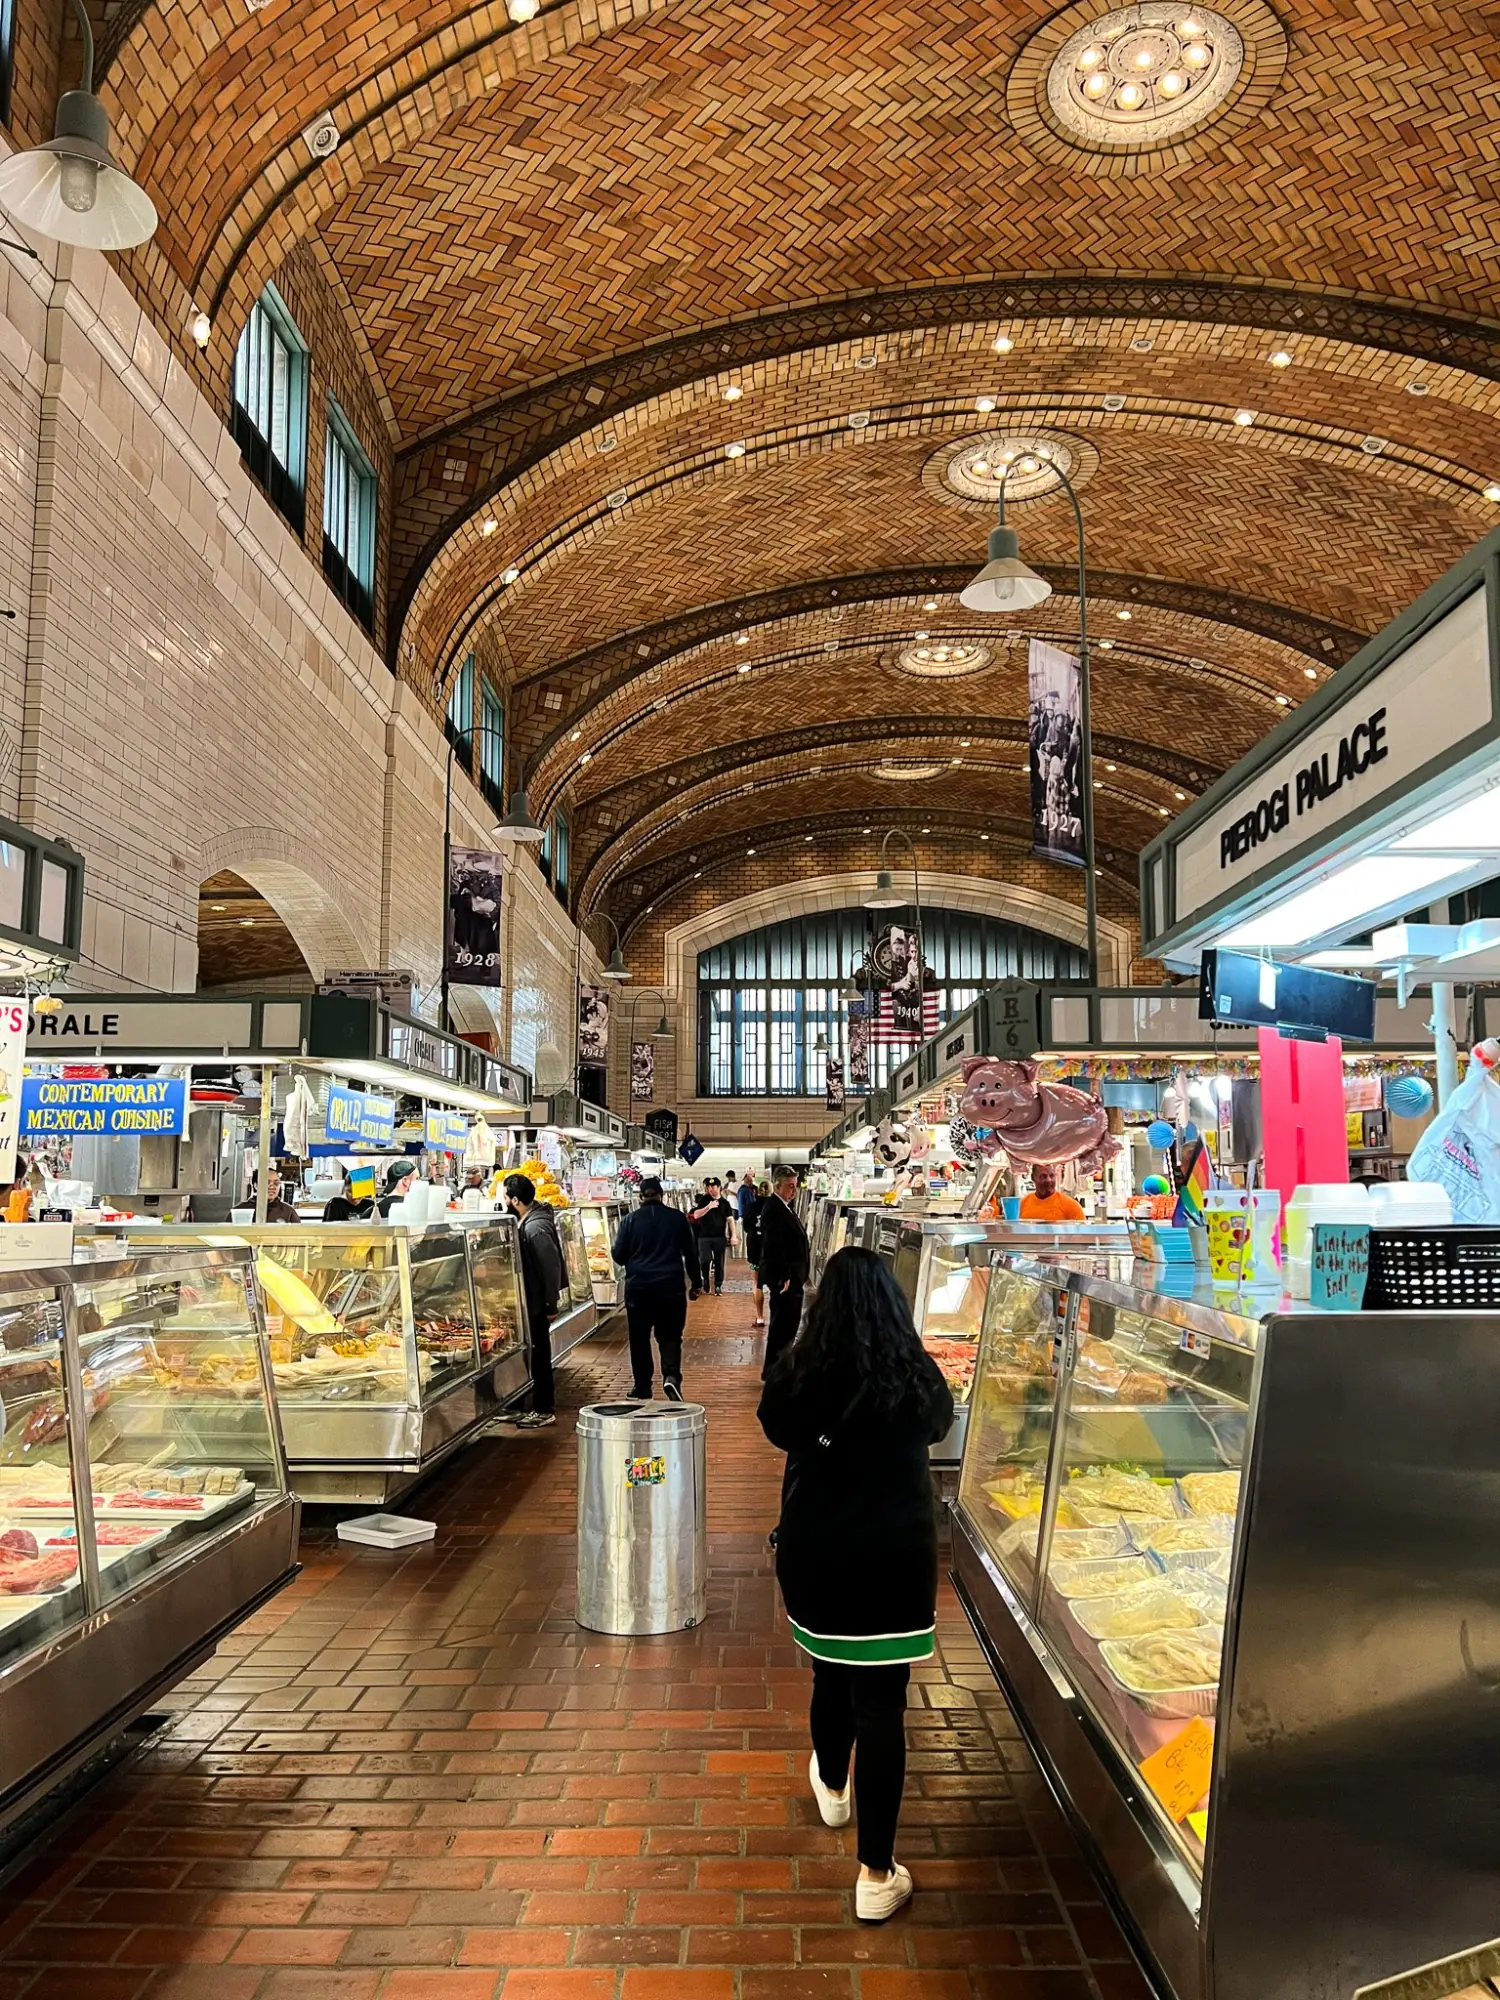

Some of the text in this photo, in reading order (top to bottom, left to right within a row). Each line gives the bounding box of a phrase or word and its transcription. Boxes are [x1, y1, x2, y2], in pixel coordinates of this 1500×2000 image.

[1220, 707, 1389, 869] PIEROGI PALACE
[1040, 808, 1082, 838] 1927
[454, 952, 496, 967] 1928
[1005, 1024, 1020, 1047] 6
[582, 1047, 606, 1058] 1945
[39, 1082, 170, 1104] CONTEMPORARY
[26, 1107, 105, 1131] MEXICAN
[111, 1107, 175, 1131] CUISINE
